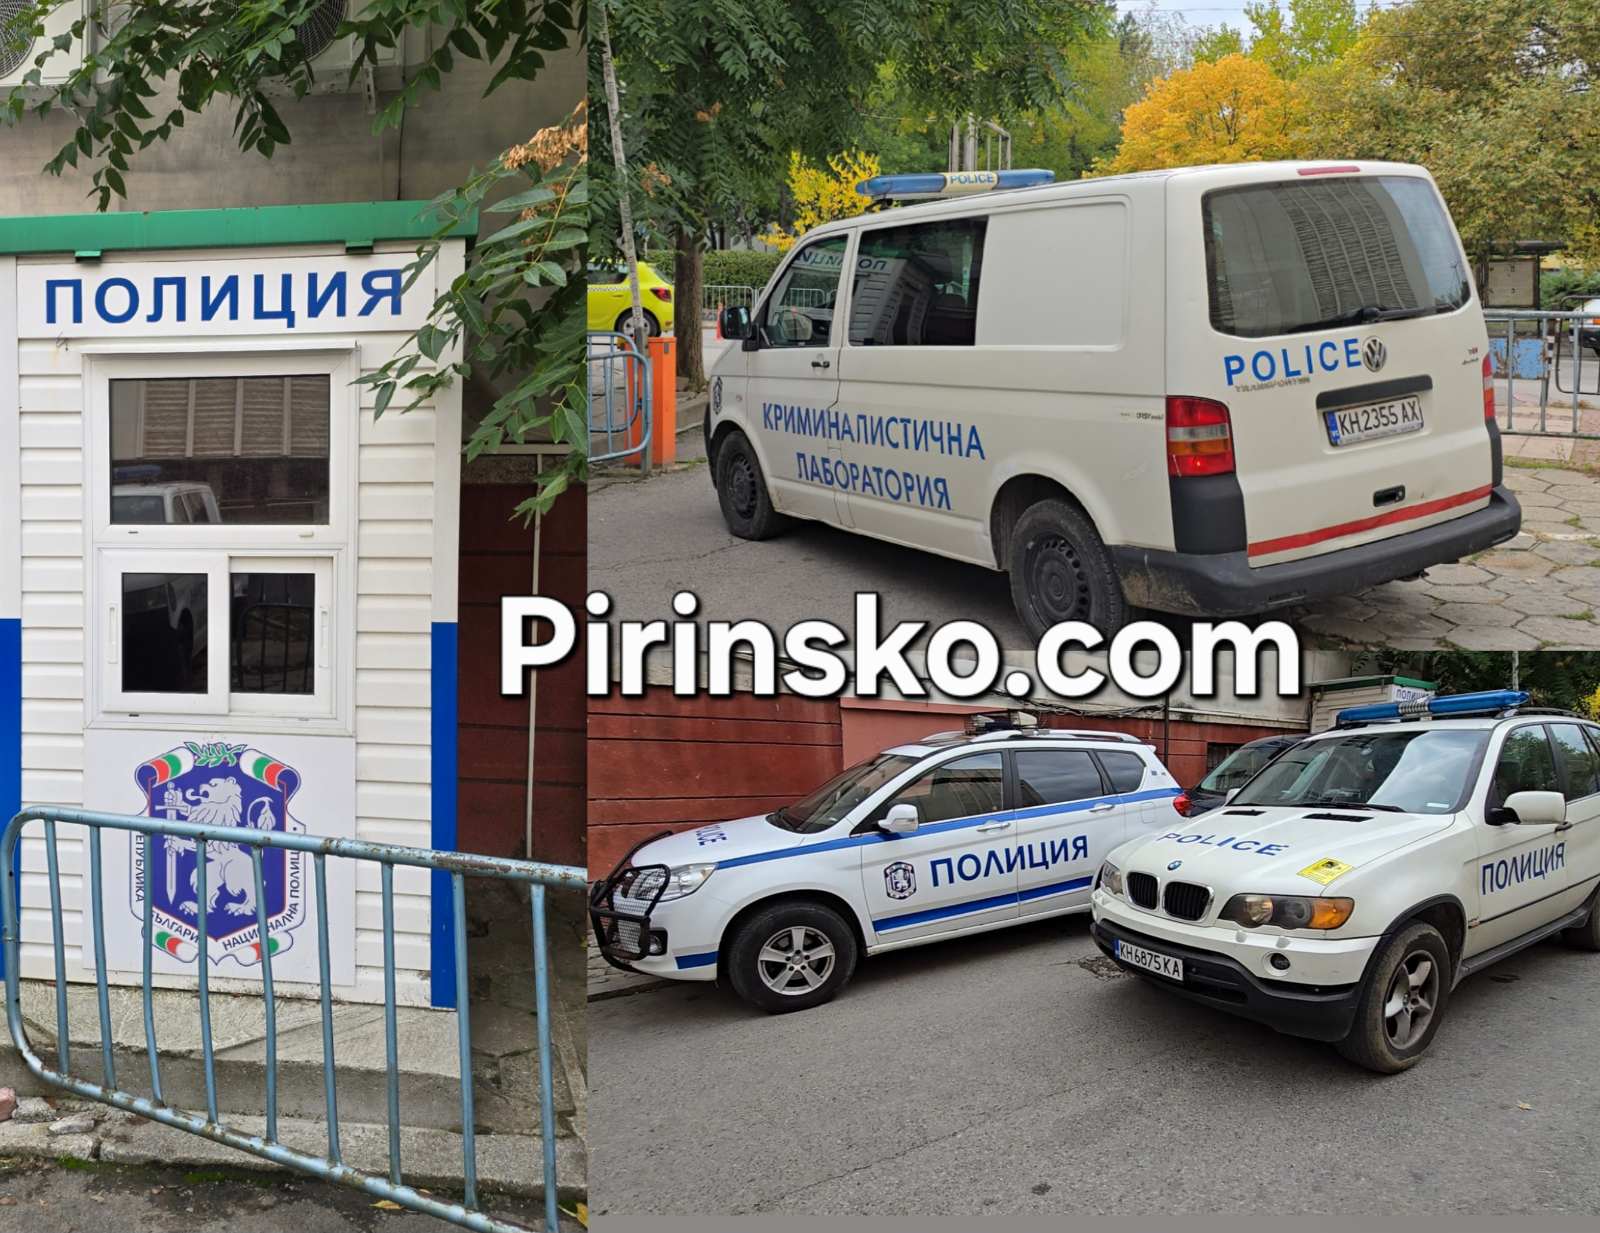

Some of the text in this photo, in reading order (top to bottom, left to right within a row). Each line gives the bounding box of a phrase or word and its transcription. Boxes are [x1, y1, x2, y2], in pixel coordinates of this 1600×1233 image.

[949, 172, 994, 185] POLICE
[45, 268, 403, 329] ПОЛИЦИЯ
[1223, 338, 1362, 387] POLICE
[762, 402, 986, 461] КРИМИНАЛИСТИЧНА
[795, 452, 952, 511] ЛАБОРАТОРИЯ
[134, 830, 145, 903] ЕПУБЛИКА
[929, 835, 1089, 888] ПОЛИЦИЯ
[1155, 832, 1290, 857] POLICE
[1481, 841, 1566, 896] ПОЛИЦИЯ
[221, 902, 300, 952] НАЦИНАЛНА
